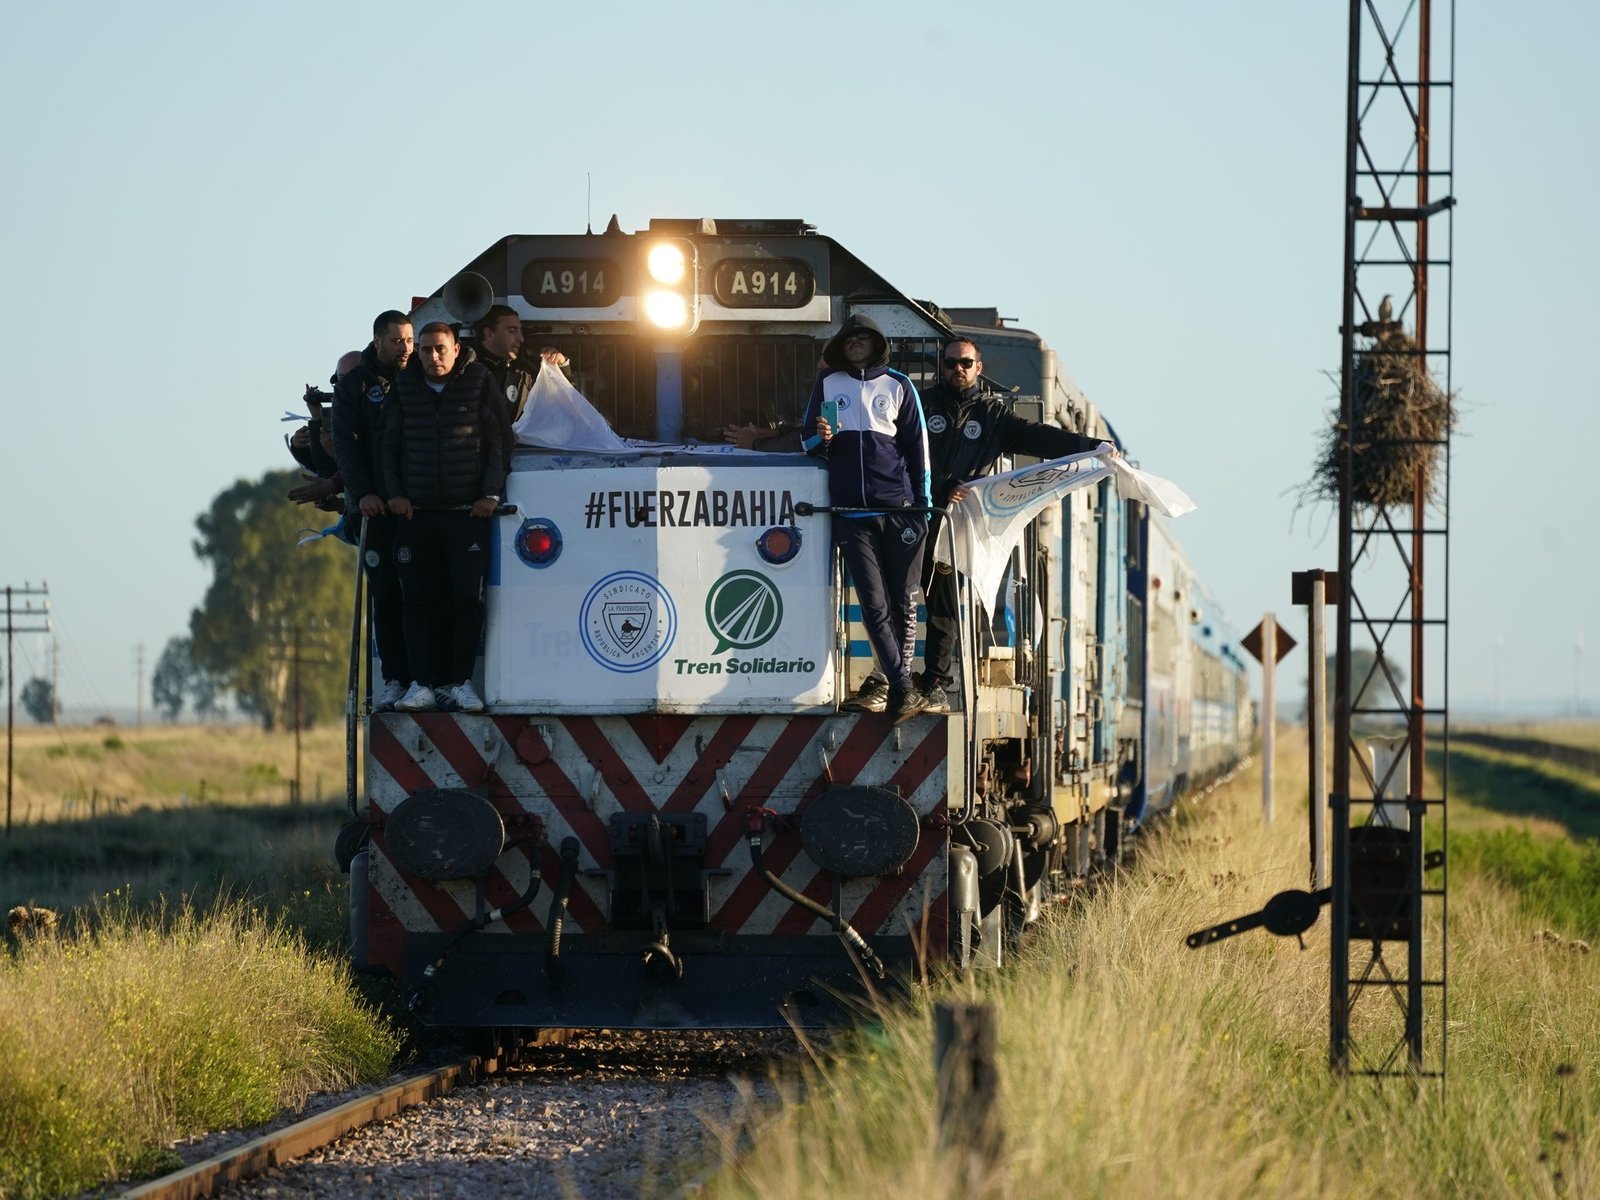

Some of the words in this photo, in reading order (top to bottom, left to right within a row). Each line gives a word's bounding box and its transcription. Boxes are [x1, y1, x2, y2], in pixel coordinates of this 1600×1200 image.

[540, 270, 605, 294] A914
[730, 270, 797, 295] A914
[584, 490, 795, 529] #FUERZABAHIA
[603, 584, 651, 600] SINDICATO
[674, 659, 723, 675] Tren
[725, 657, 816, 675] Solidario
